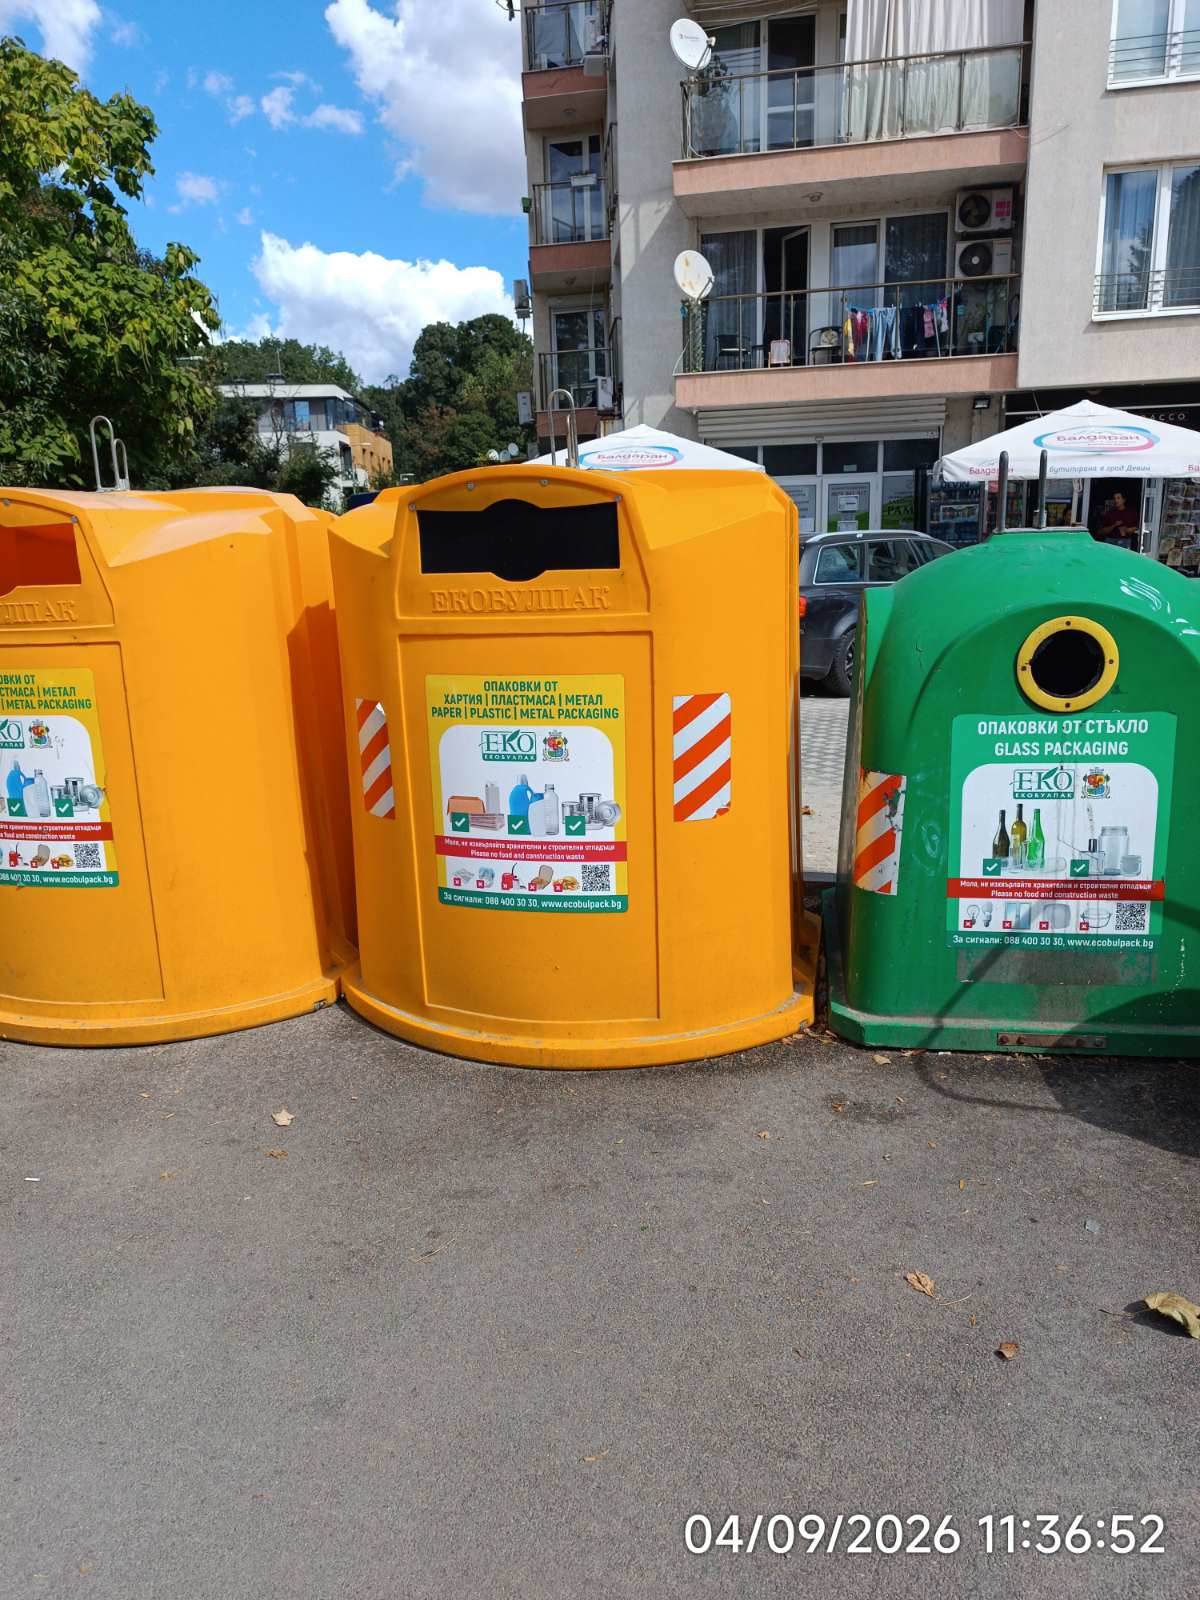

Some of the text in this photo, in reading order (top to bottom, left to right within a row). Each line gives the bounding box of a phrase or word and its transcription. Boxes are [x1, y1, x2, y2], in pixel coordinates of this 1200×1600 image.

[969, 466, 1014, 475] Балдан
[430, 586, 610, 613] ЕКОБУЛПАК
[24, 675, 35, 685] ОТ
[43, 687, 76, 697] МЕТАЛ
[484, 681, 558, 692] ОПАКОВКИ ОТ
[6, 699, 36, 709] METAL
[37, 699, 92, 709] PACKAGING
[444, 694, 482, 705] ХАРТИЯ
[491, 694, 557, 706] ПЛАСТМАСА
[565, 694, 603, 706] МЕТАЛ
[431, 706, 462, 718] PAPER
[470, 707, 511, 719] PLASTIC
[520, 708, 555, 719] METAL
[557, 708, 619, 719] PACKAGING
[977, 719, 1149, 735] ОПАКОВКИ ОТ СТЪКЛО
[995, 741, 1129, 756] GLASS PACKAGING
[513, 851, 524, 859] and
[526, 852, 564, 860] construction
[23, 874, 31, 882] 30
[43, 875, 113, 885] www.ecobulpack.bg
[443, 891, 452, 900] За
[453, 894, 484, 903] сигнали:
[500, 897, 515, 906] 400
[516, 898, 526, 907] 30
[541, 900, 622, 910] www.ecobulpack.bg
[1054, 891, 1097, 899] construction
[953, 935, 963, 944] За
[965, 936, 1002, 945] сигнали:
[1004, 936, 1020, 945] 088
[1022, 937, 1038, 945] 400
[1040, 937, 1051, 946] 30
[1067, 938, 1154, 949] www.ecobulpack.bg
